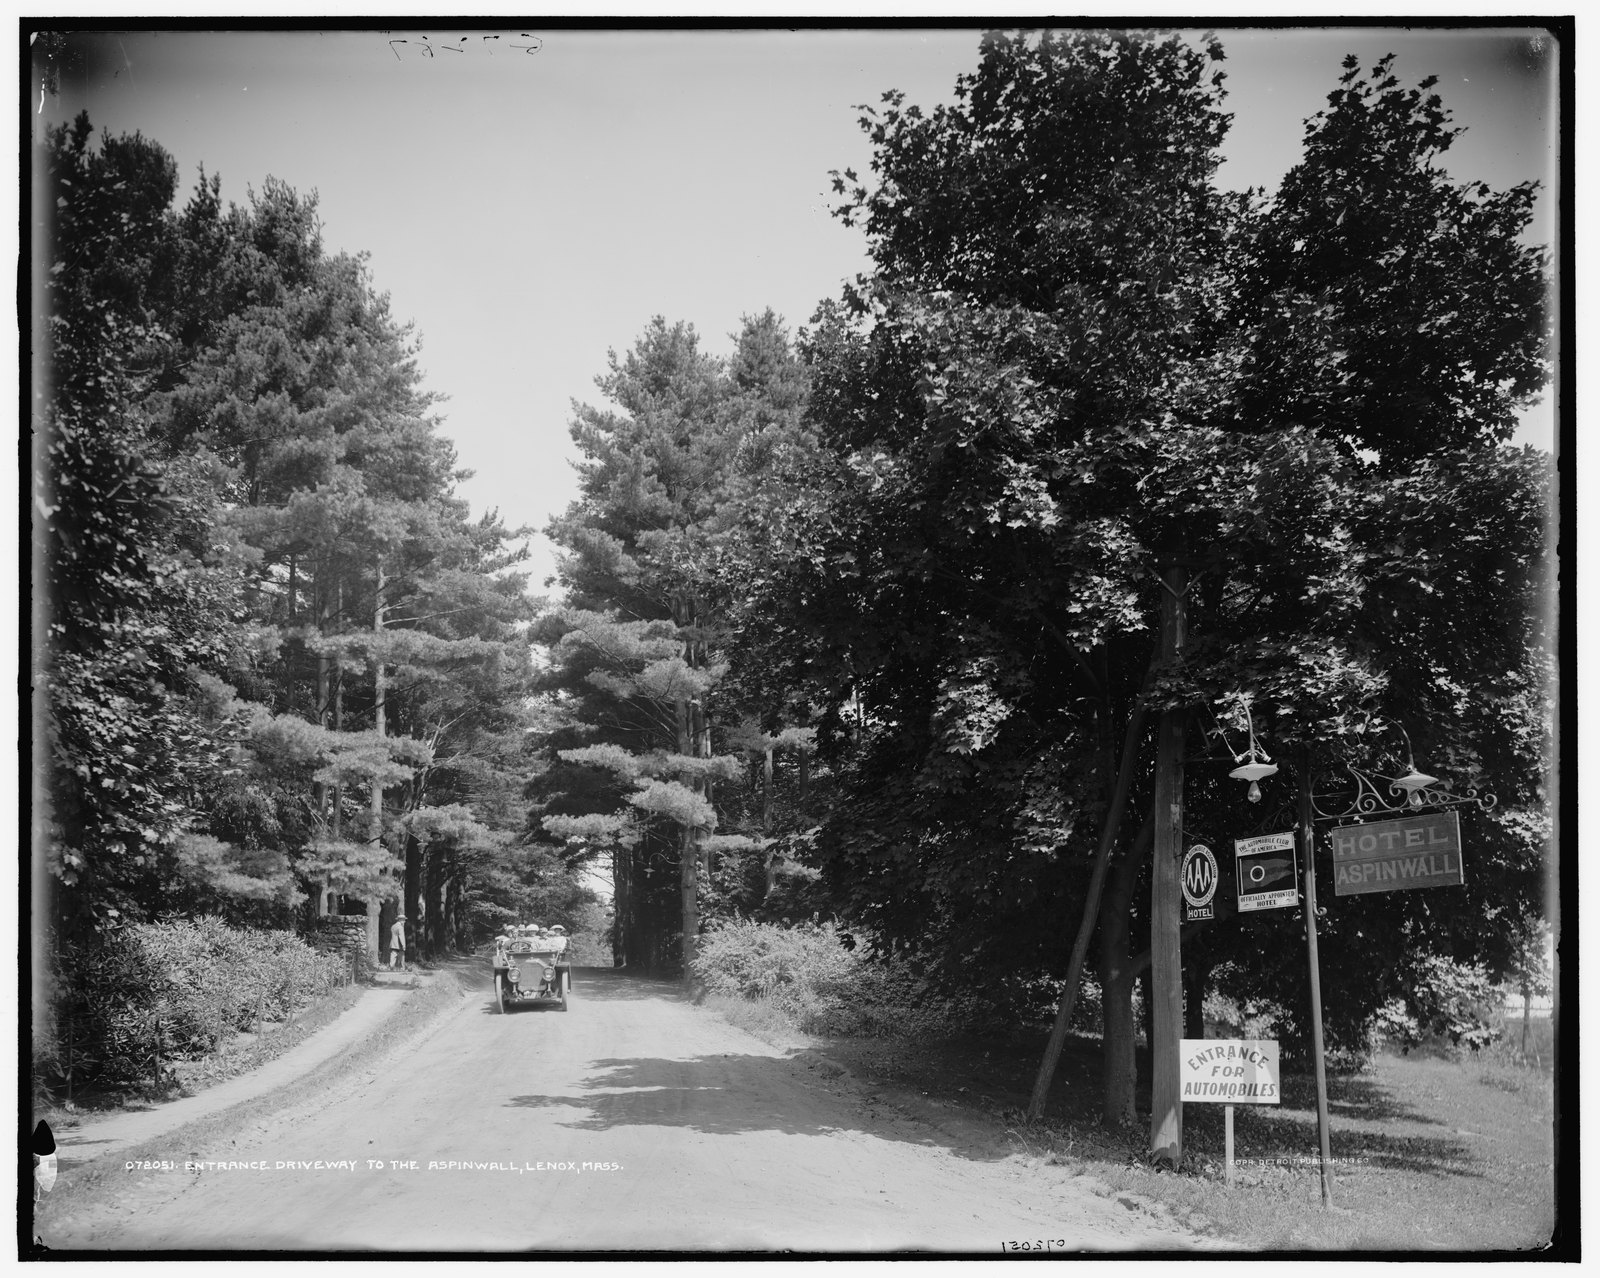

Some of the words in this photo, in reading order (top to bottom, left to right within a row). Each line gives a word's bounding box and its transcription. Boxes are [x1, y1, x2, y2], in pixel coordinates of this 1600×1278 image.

[1248, 838, 1275, 848] AUTOMOBILE
[1337, 826, 1450, 856] HOTEL
[1187, 858, 1211, 893] AAA
[1337, 853, 1458, 886] ASPINWALL
[1240, 894, 1267, 902] OFFICIALLY
[1268, 891, 1295, 899] APPOINTED
[1256, 899, 1276, 907] HOTEL
[1188, 908, 1213, 918] HOTEL
[1187, 1045, 1270, 1072] ENTRANCE
[1211, 1065, 1245, 1078] FOR
